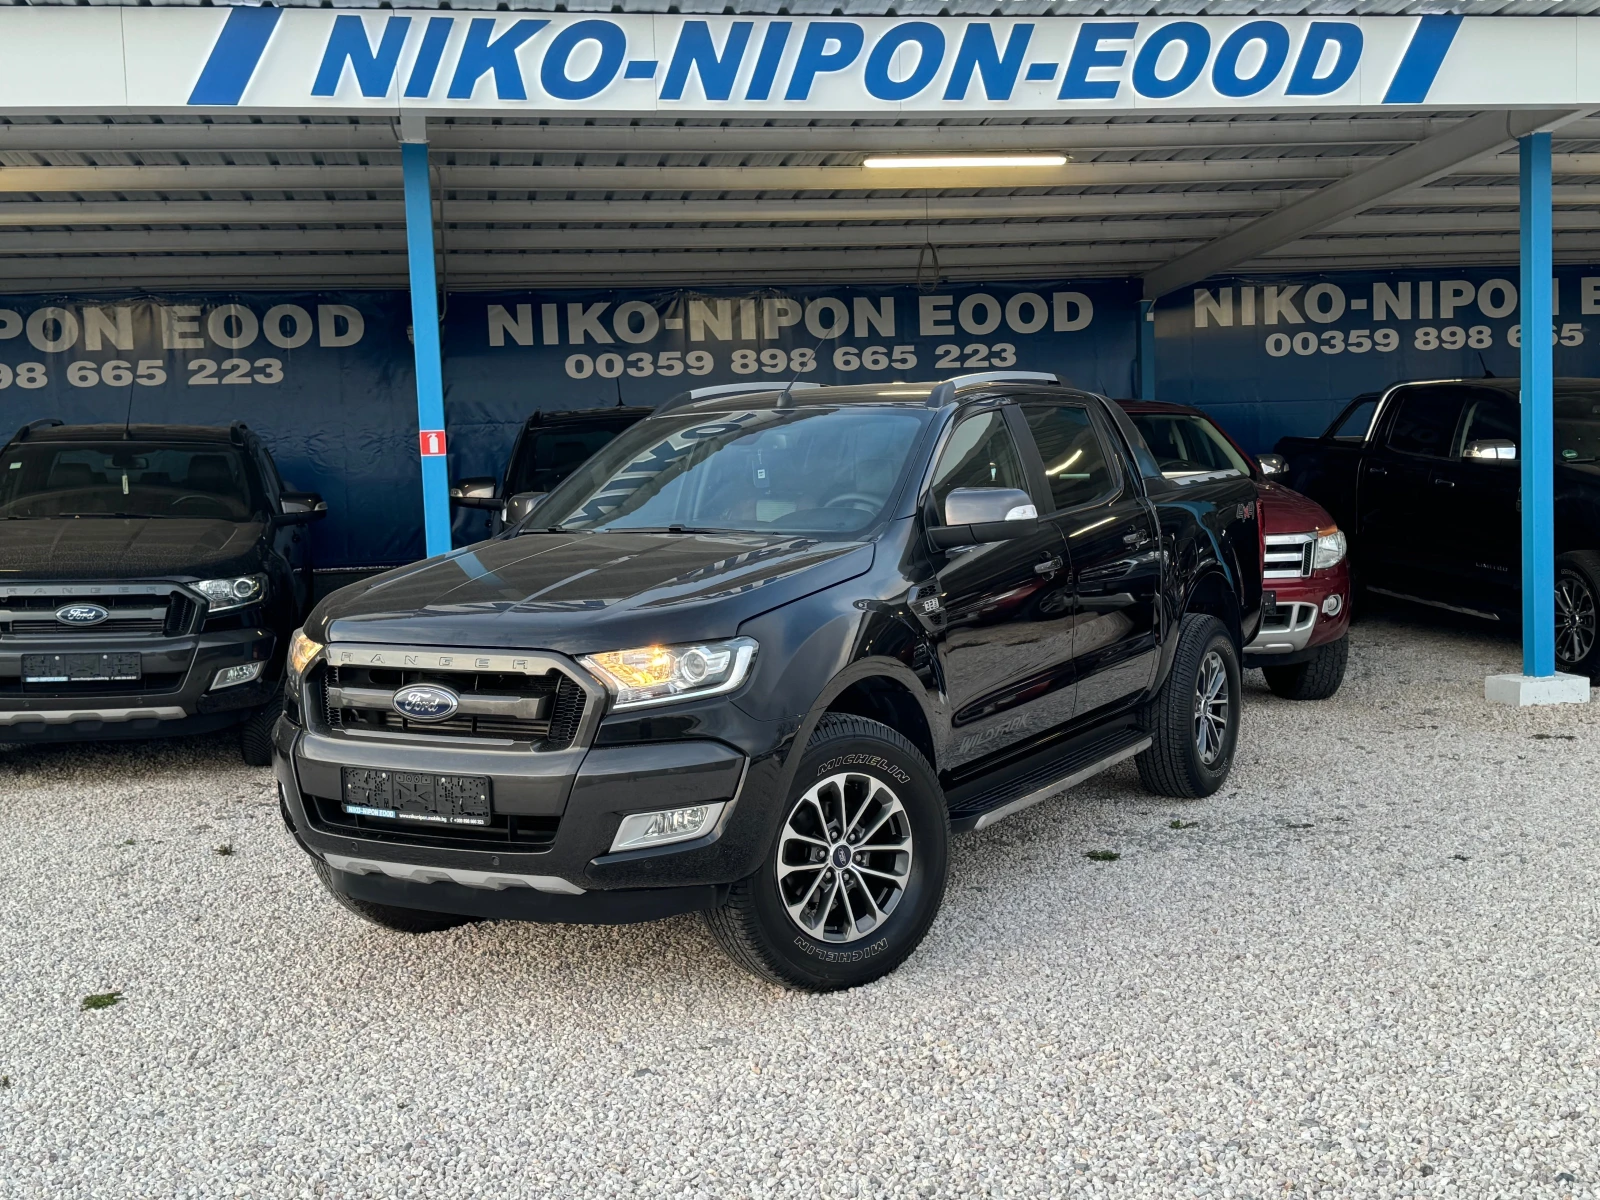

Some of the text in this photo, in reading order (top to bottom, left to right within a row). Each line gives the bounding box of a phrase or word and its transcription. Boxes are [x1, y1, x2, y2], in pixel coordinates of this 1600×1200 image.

[310, 14, 1364, 101] NIKO-NIPON-EOOD
[160, 303, 365, 350] EOOD
[487, 291, 1094, 347] NIKO-NIPON EOOD
[1265, 328, 1400, 357] 00359
[1413, 325, 1493, 351] 898
[66, 359, 167, 388] 665
[187, 357, 284, 385] 223
[565, 343, 1017, 379] 00359 898 665 223
[6, 587, 157, 595] RANGER
[67, 608, 96, 620] Ford
[340, 651, 529, 670] RANGER
[404, 692, 439, 712] Ford
[959, 712, 1030, 754] WILDTRAK
[817, 753, 910, 784] MICHELIN
[794, 936, 889, 963] MICHELIN
